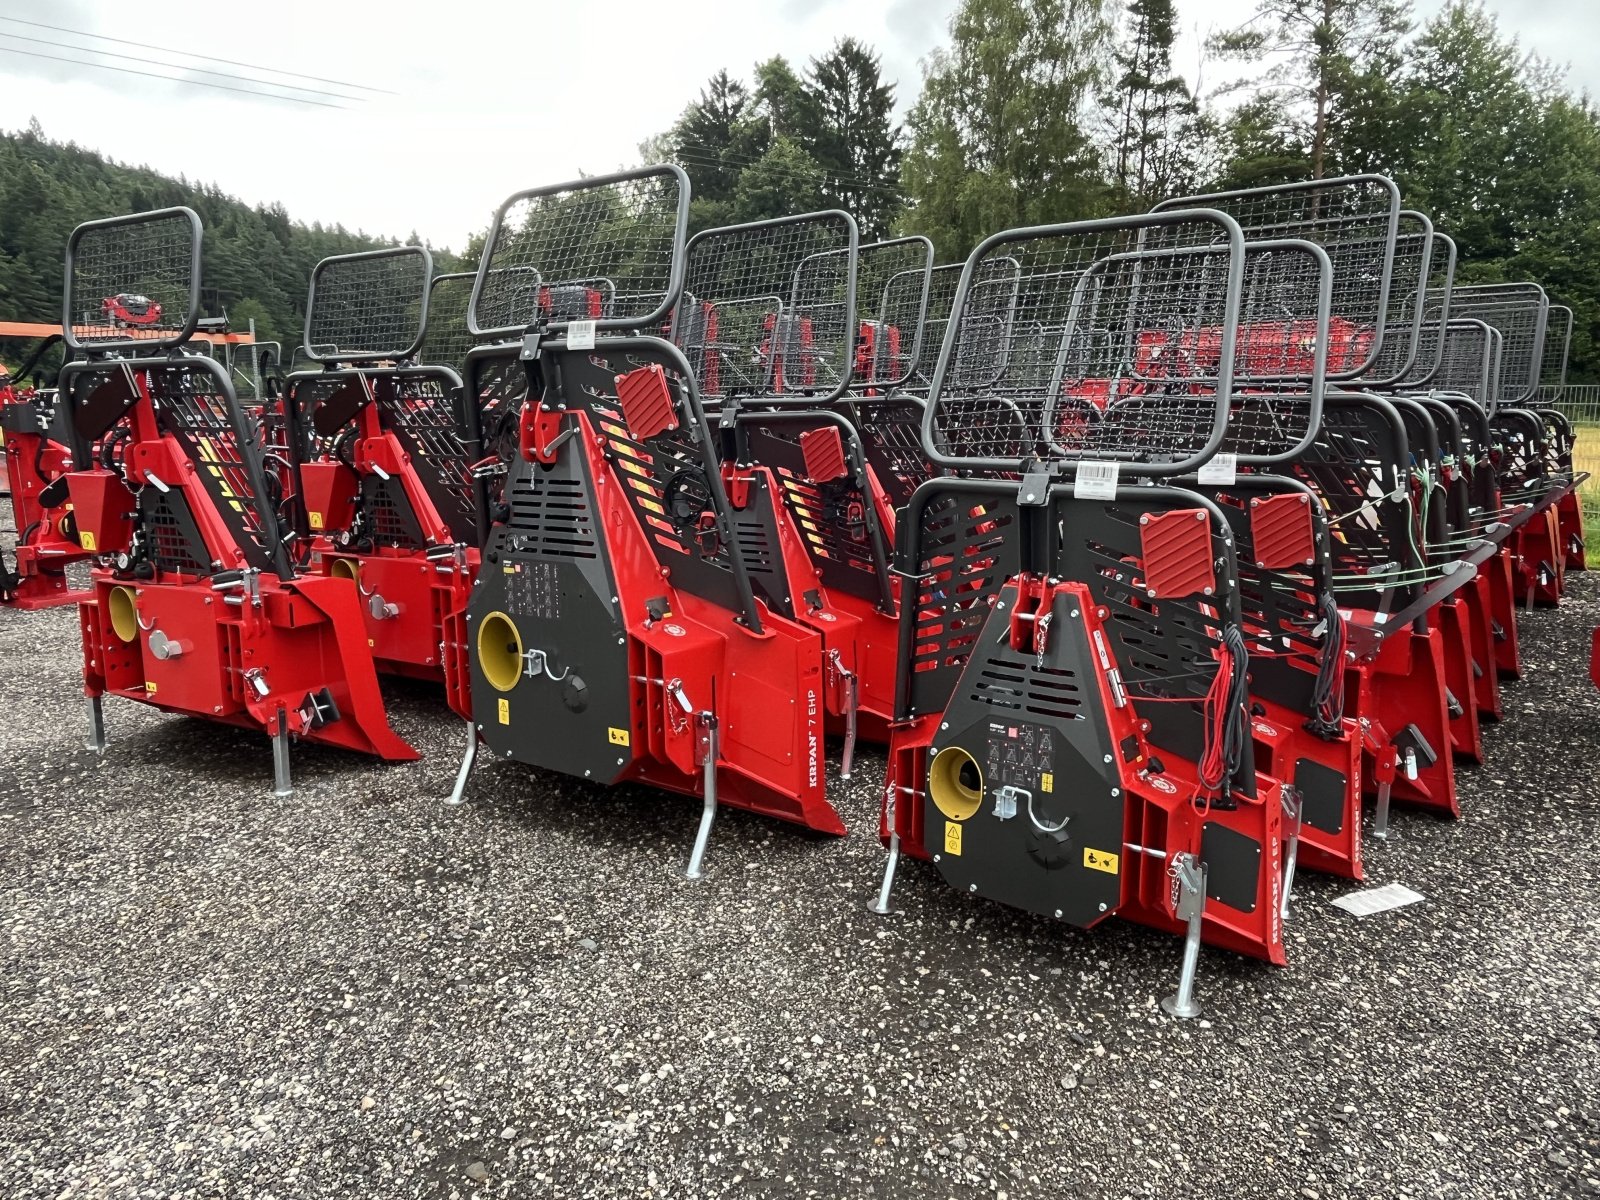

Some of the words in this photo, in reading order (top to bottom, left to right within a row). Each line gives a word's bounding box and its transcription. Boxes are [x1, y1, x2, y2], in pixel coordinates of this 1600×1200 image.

[808, 690, 816, 716] EHP
[808, 719, 816, 727] 7
[808, 736, 817, 788] KRPAN
